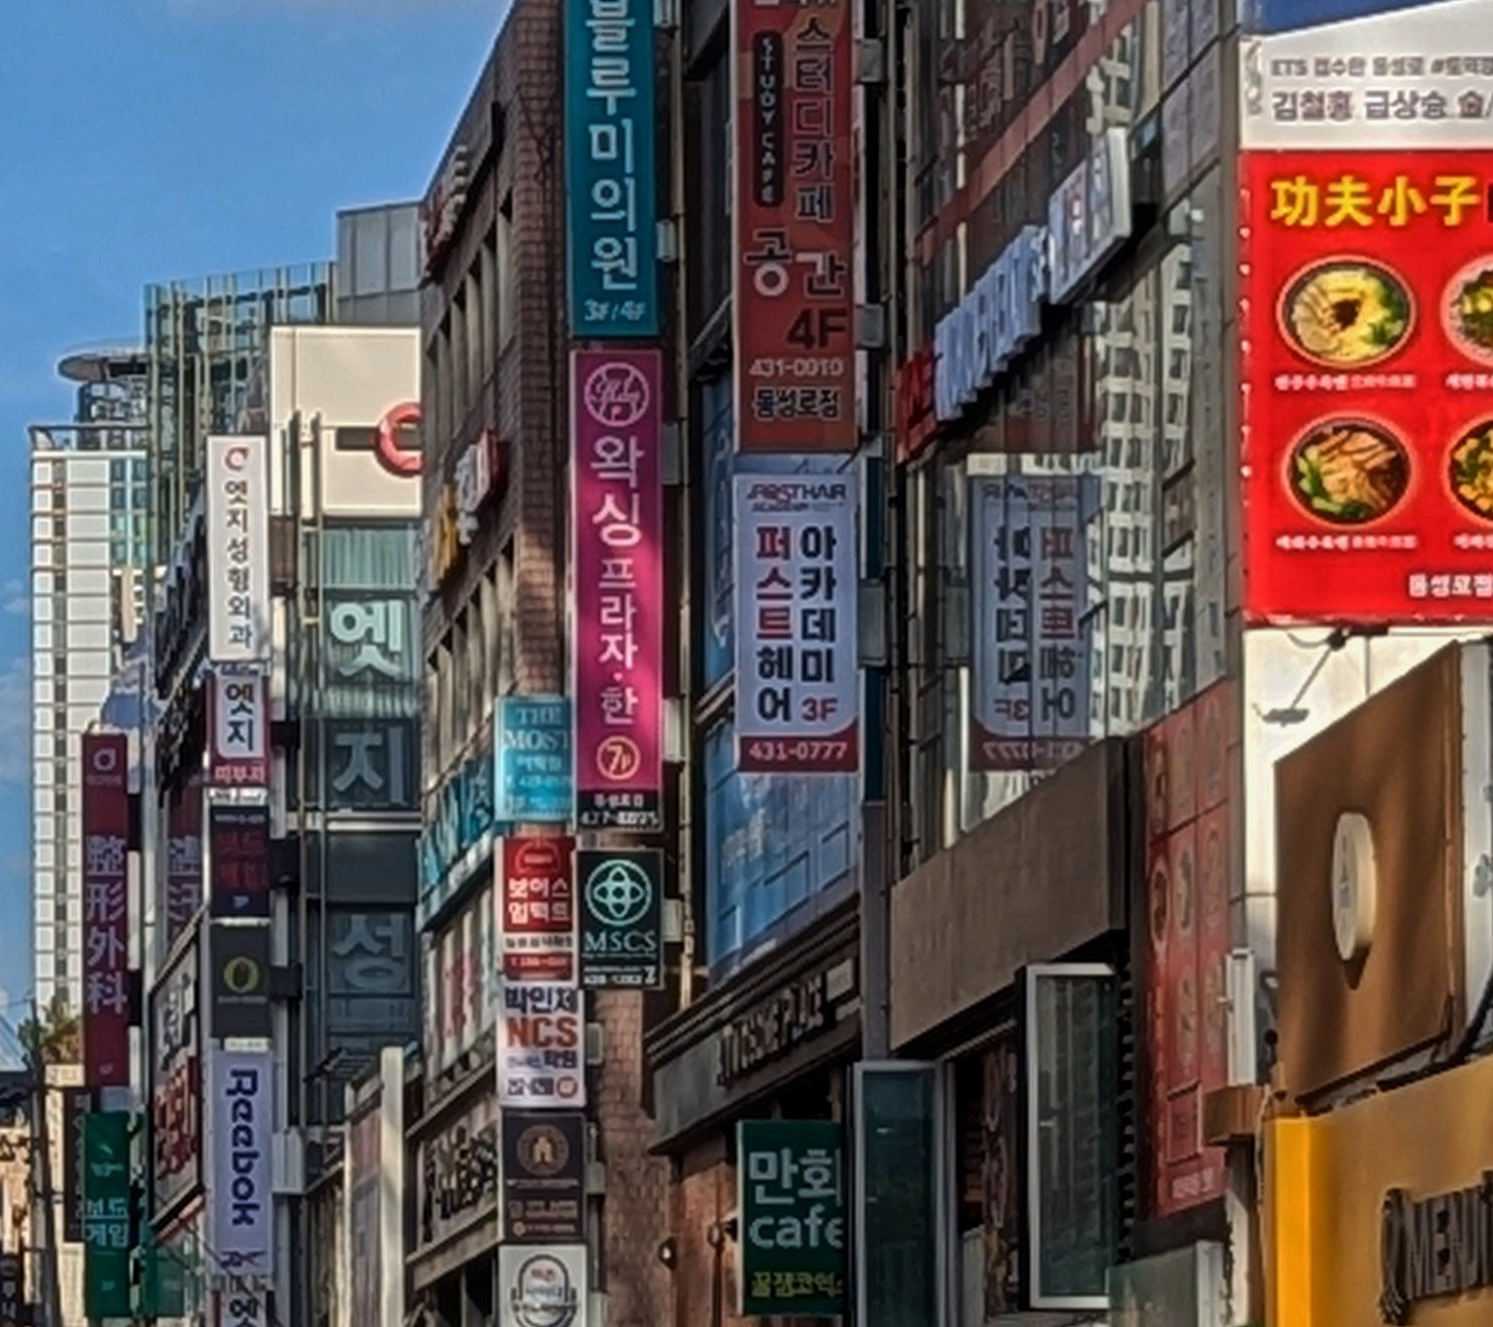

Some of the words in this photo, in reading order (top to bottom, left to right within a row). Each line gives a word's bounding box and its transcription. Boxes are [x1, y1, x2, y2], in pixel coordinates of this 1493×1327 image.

[793, 17, 835, 222] 스터디카페
[1365, 89, 1447, 119] 급상승
[1270, 176, 1479, 228] 功夫小子
[746, 231, 847, 297] 공간
[787, 308, 847, 350] 4F
[752, 390, 841, 421] 동성로점
[224, 479, 252, 649] 엣지성형외과
[756, 525, 794, 723] 퍼스트헤어
[799, 525, 837, 684] 아카데미
[226, 683, 255, 751] 엣지
[801, 698, 838, 722] 3F
[748, 742, 847, 762] 431-0777
[85, 835, 128, 1015] 整形外科
[584, 932, 657, 953] MSCS
[507, 1018, 578, 1049] NCS
[225, 1070, 260, 1226] Reebok
[749, 1148, 842, 1207] 만화
[85, 1223, 128, 1248] 게임
[749, 1204, 843, 1249] cafe
